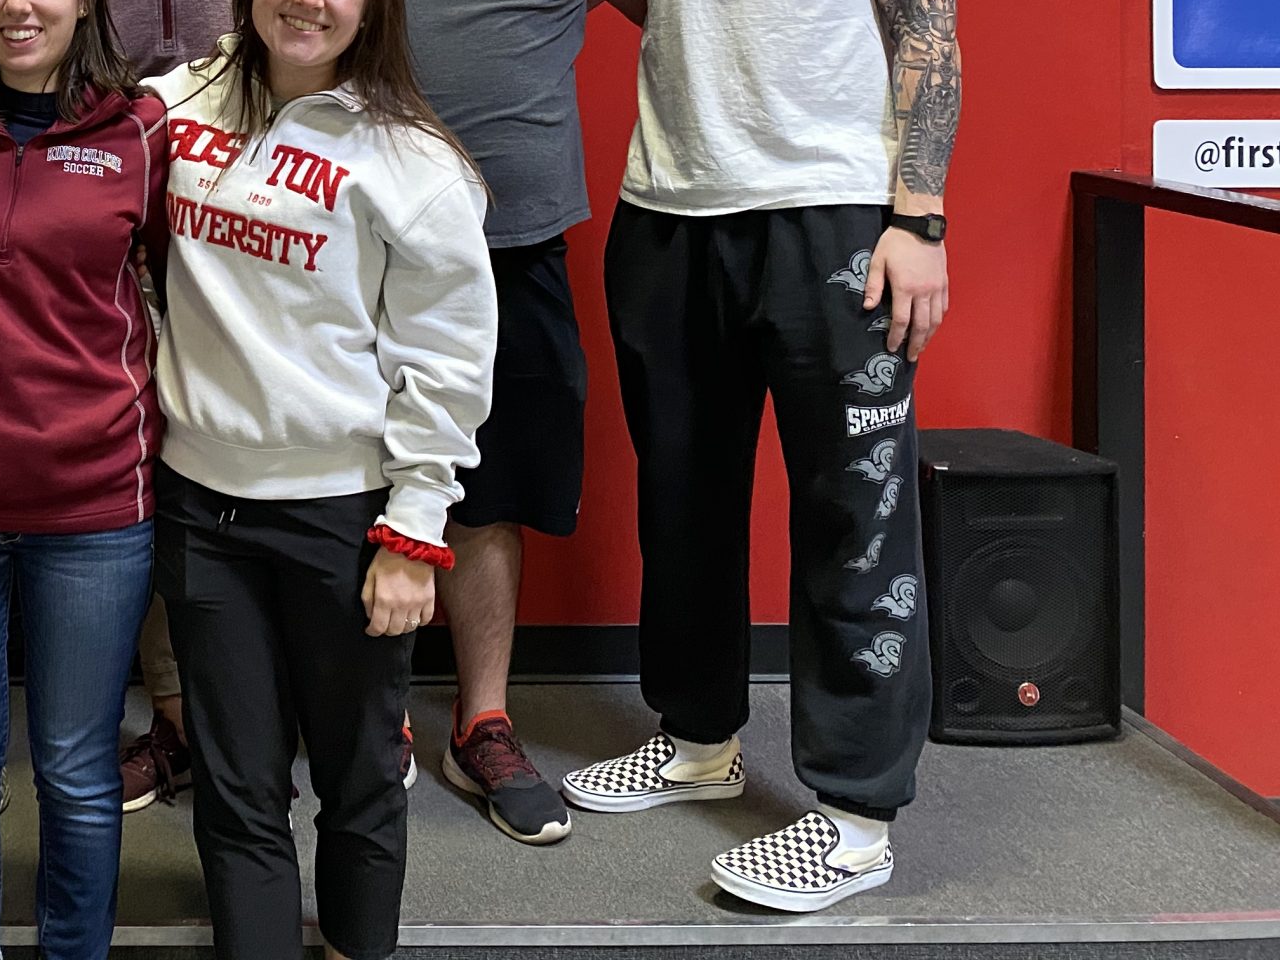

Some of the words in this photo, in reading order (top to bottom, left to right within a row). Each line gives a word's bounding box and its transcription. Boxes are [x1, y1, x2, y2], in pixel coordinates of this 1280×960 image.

[63, 162, 104, 177] SOCCER
[246, 192, 273, 206] 1839
[166, 192, 329, 272] NIVERSITY
